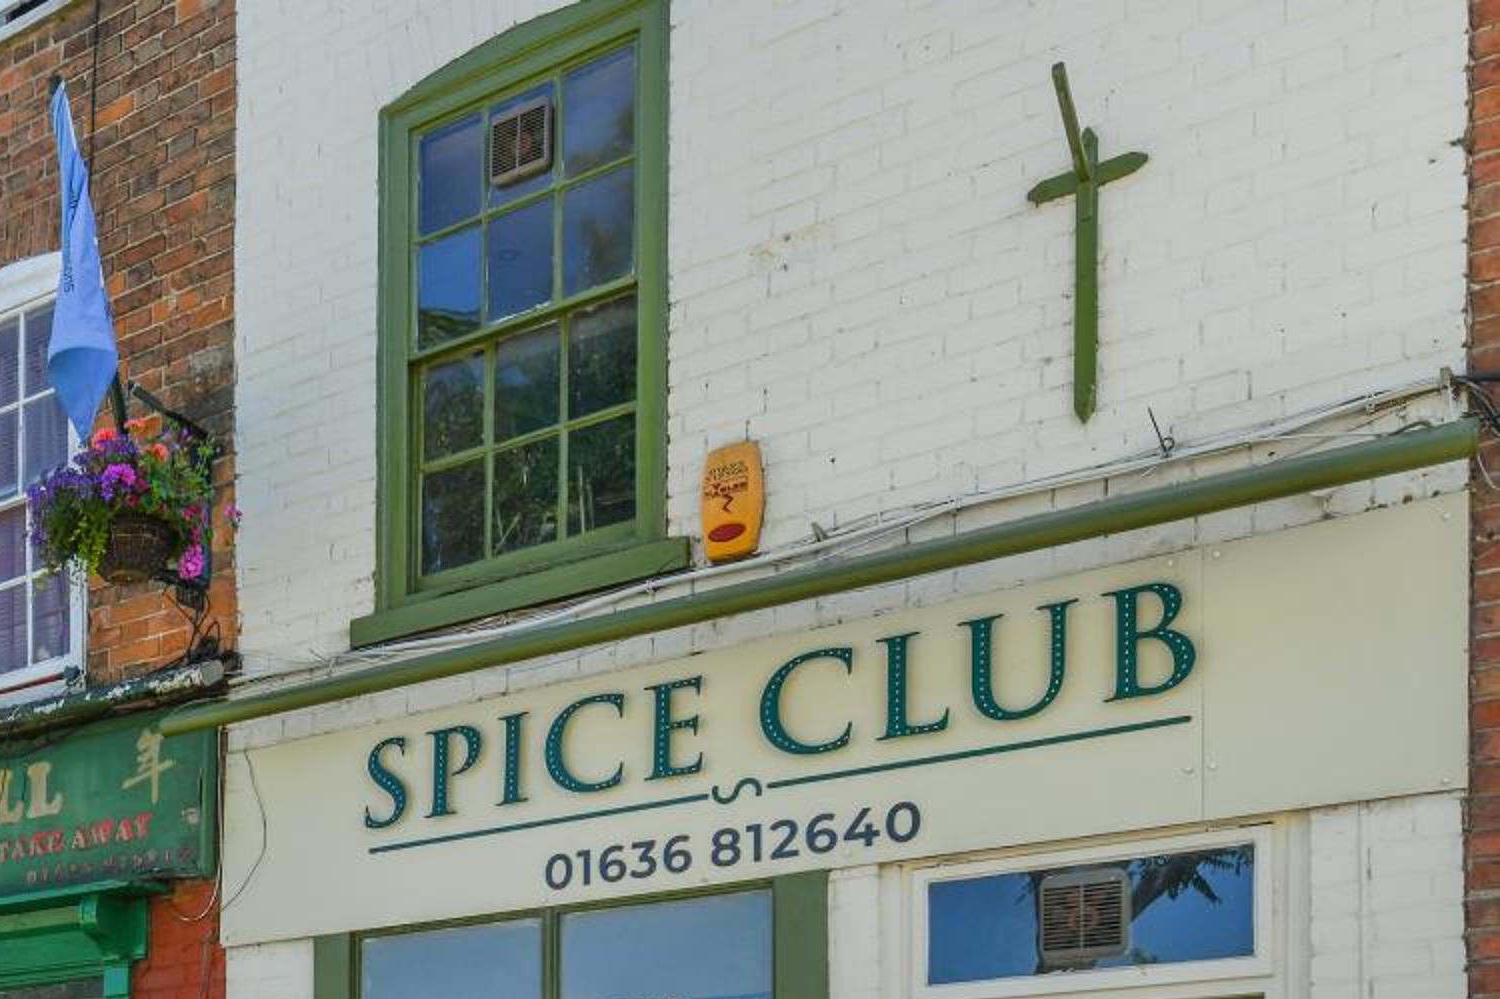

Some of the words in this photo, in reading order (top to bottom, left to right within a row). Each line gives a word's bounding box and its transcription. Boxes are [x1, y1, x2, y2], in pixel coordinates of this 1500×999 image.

[363, 674, 704, 830] SPICE
[757, 579, 1197, 757] CLUB
[71, 812, 154, 850] AWAY
[544, 834, 693, 891] 01636
[710, 800, 922, 868] 812640
